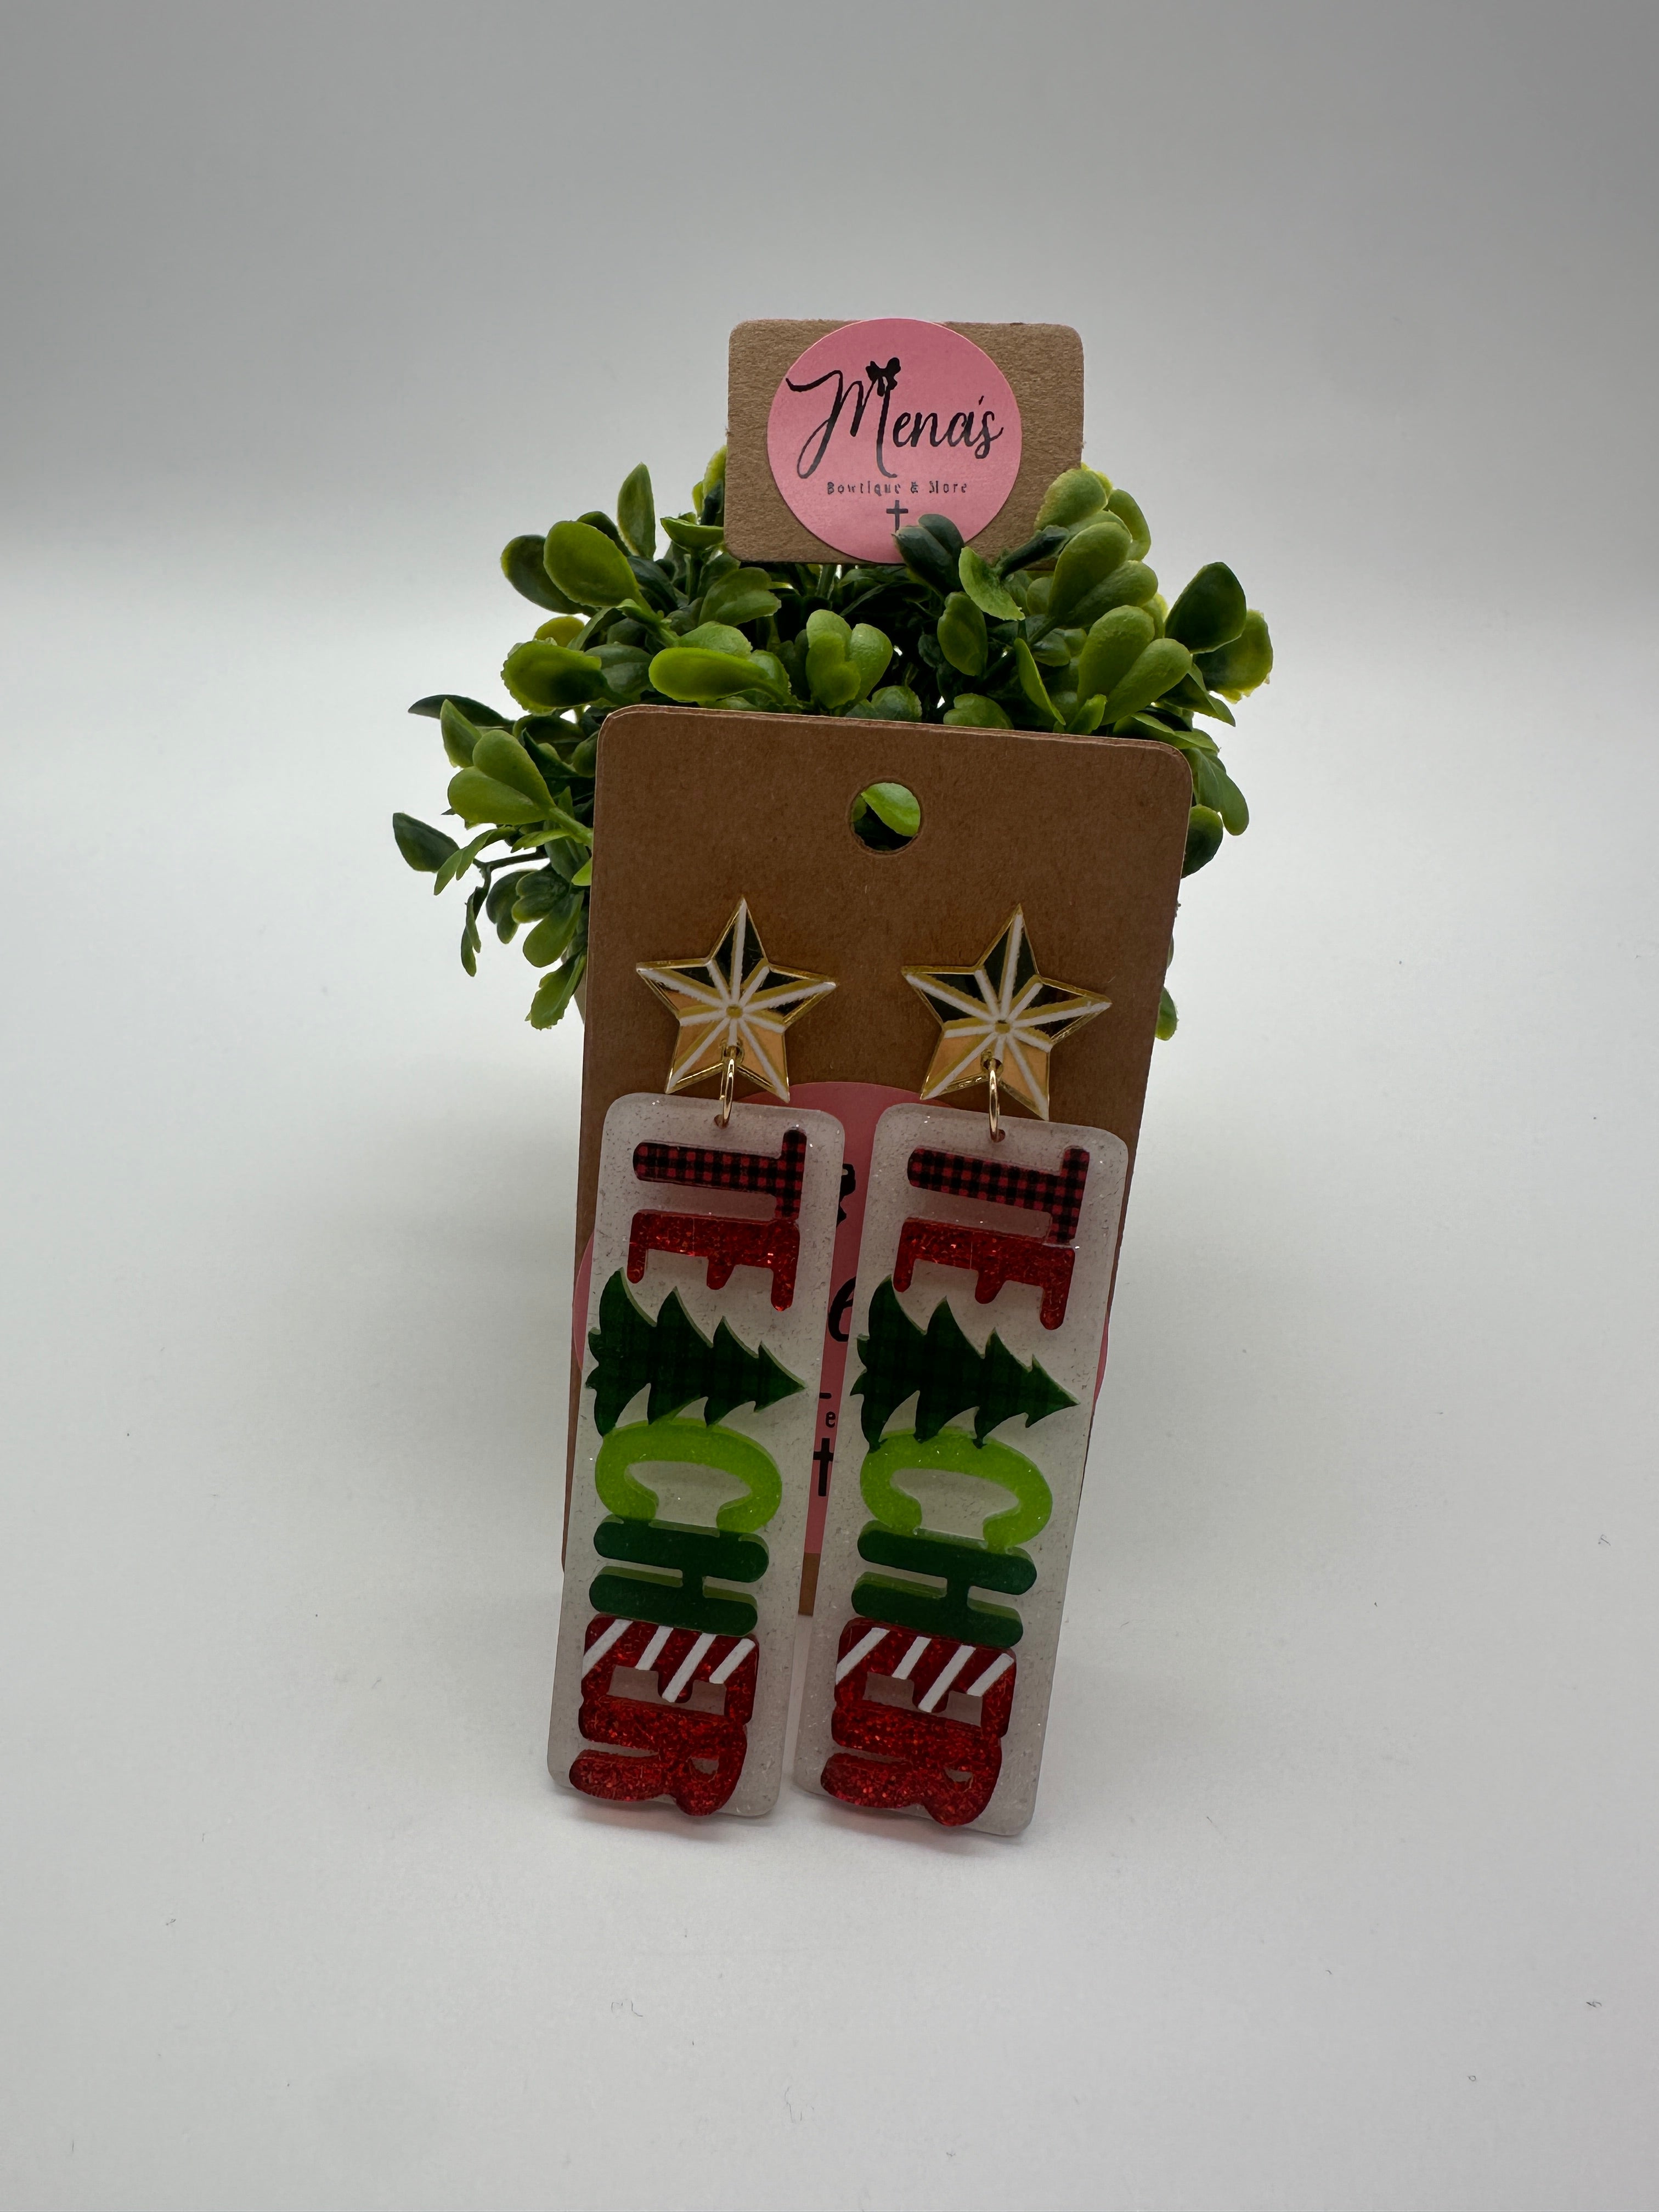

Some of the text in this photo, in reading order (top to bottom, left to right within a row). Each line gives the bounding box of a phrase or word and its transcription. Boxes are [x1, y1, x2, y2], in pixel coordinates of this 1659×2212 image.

[786, 358, 1004, 478] Mena's
[910, 481, 919, 494] &
[929, 480, 968, 494] More
